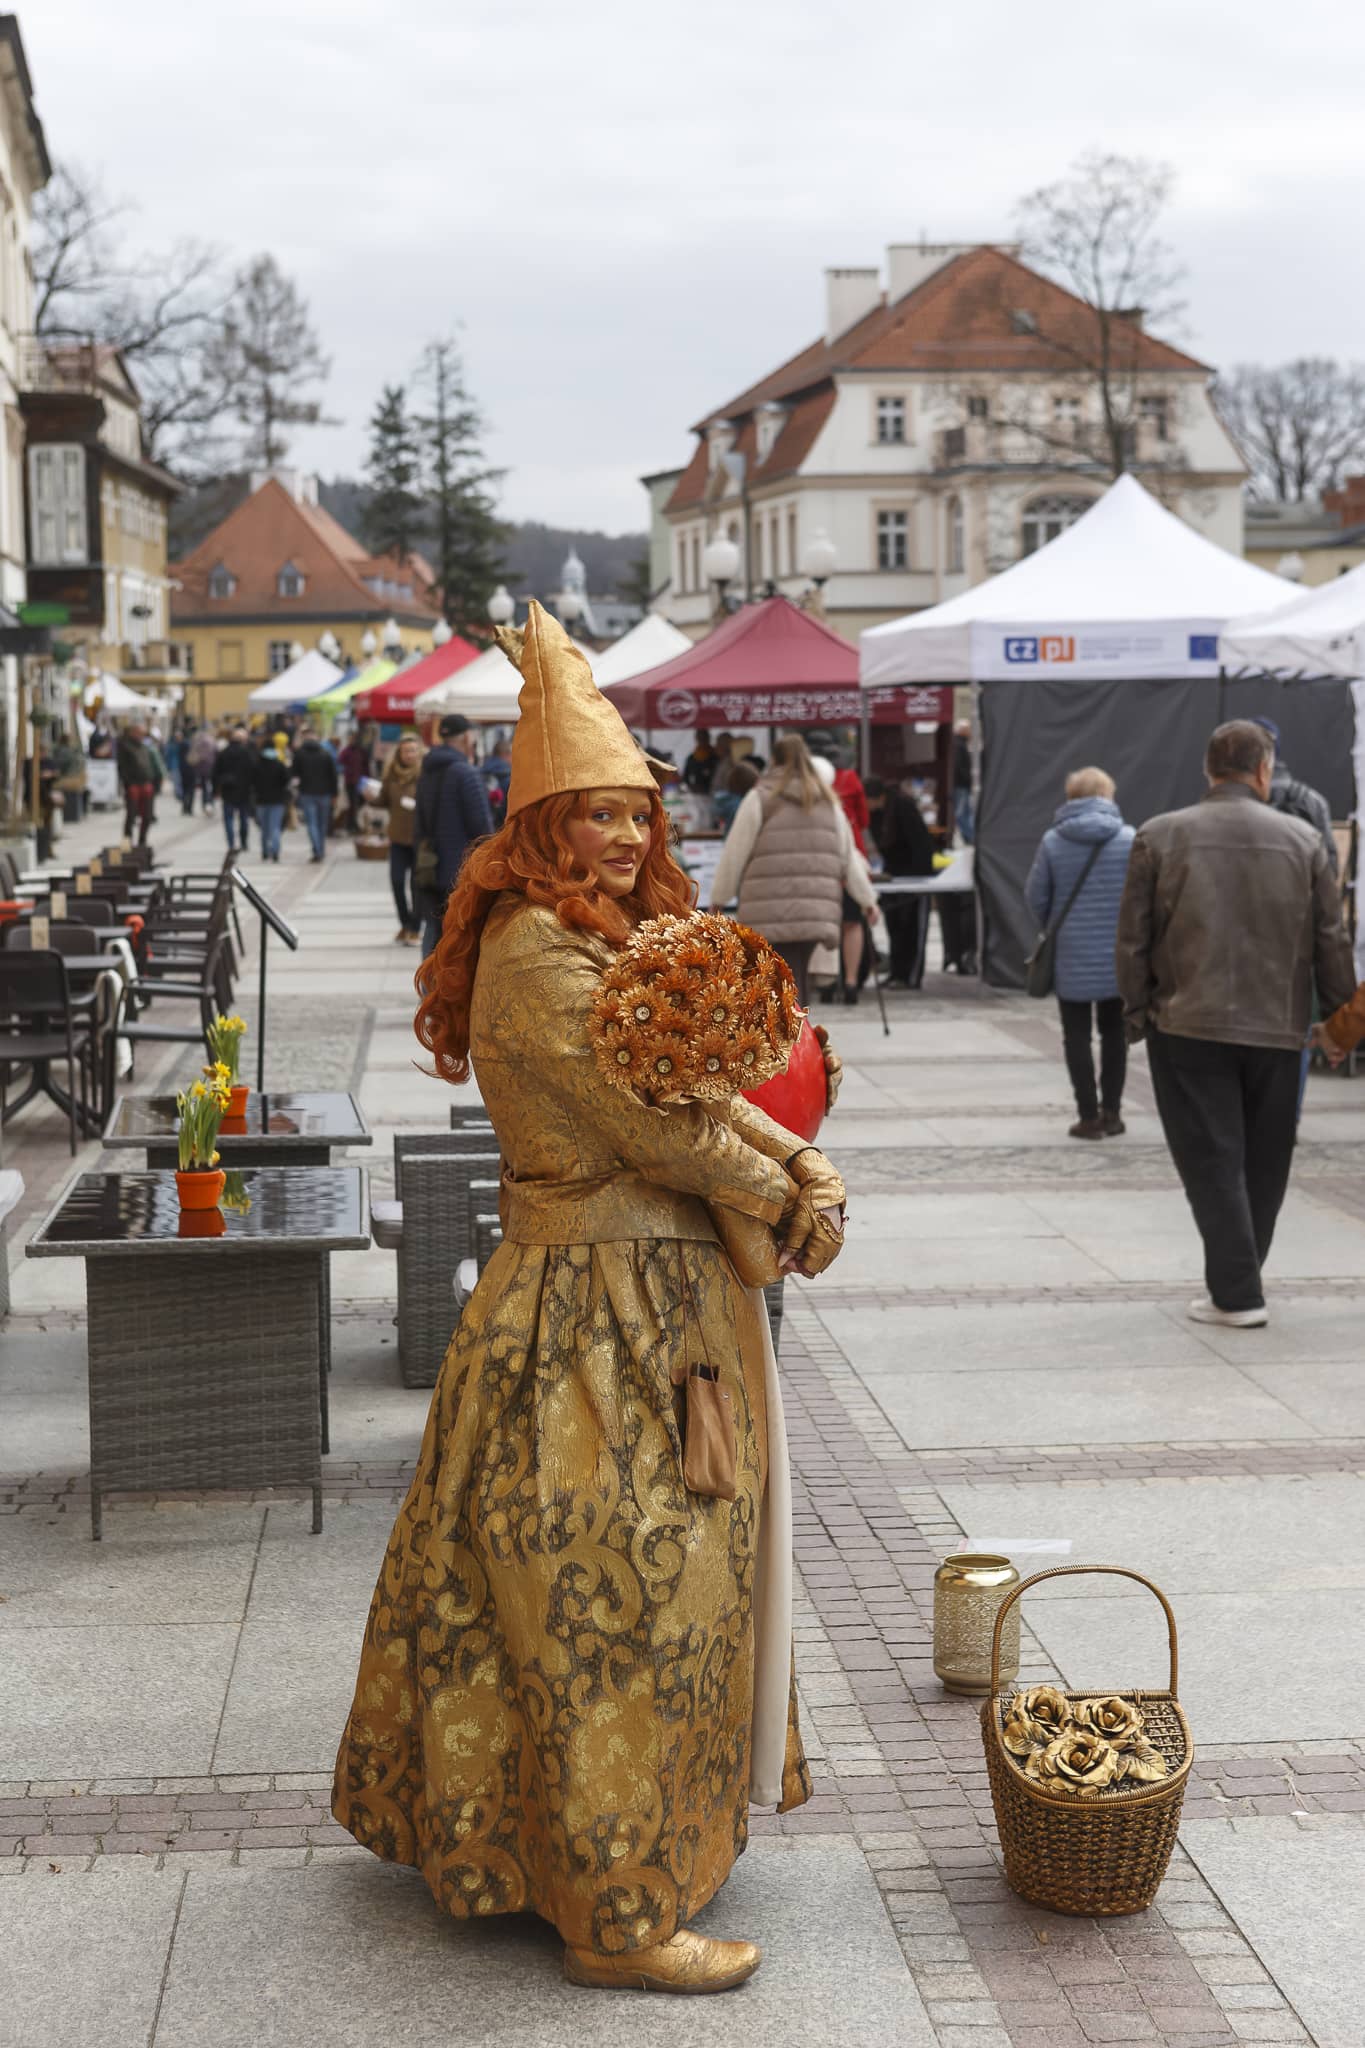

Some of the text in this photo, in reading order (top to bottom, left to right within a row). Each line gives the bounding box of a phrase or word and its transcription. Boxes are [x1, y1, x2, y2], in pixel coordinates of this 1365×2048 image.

[700, 692, 771, 707] MUZEUM
[725, 705, 743, 722] W
[748, 704, 818, 721] JELENIEJ
